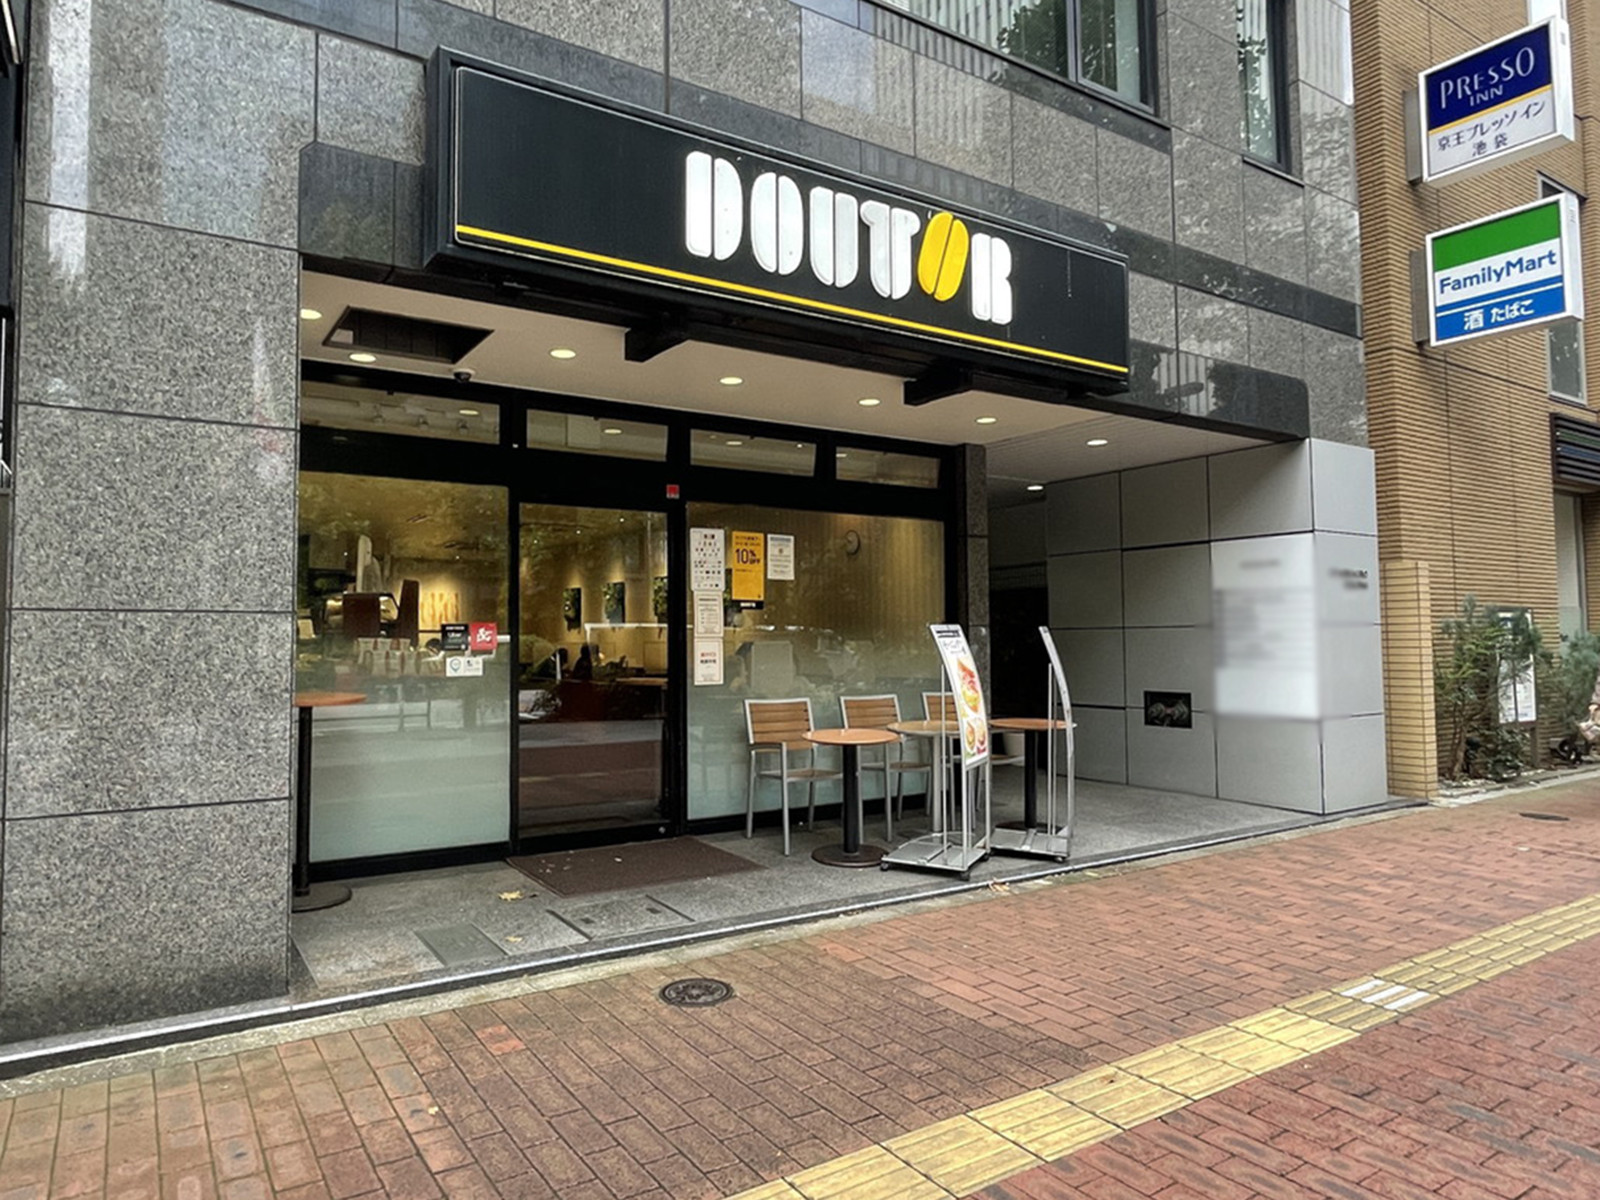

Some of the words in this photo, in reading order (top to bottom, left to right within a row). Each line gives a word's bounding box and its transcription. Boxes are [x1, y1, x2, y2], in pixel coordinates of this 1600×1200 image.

[1441, 47, 1535, 109] PRESSO
[1470, 84, 1503, 107] INN
[1472, 132, 1508, 157] 池袋
[685, 151, 1013, 325] DOUTOR
[1440, 250, 1556, 294] FamilyMart
[1464, 309, 1484, 331] 酒
[1491, 300, 1534, 323] たばこ
